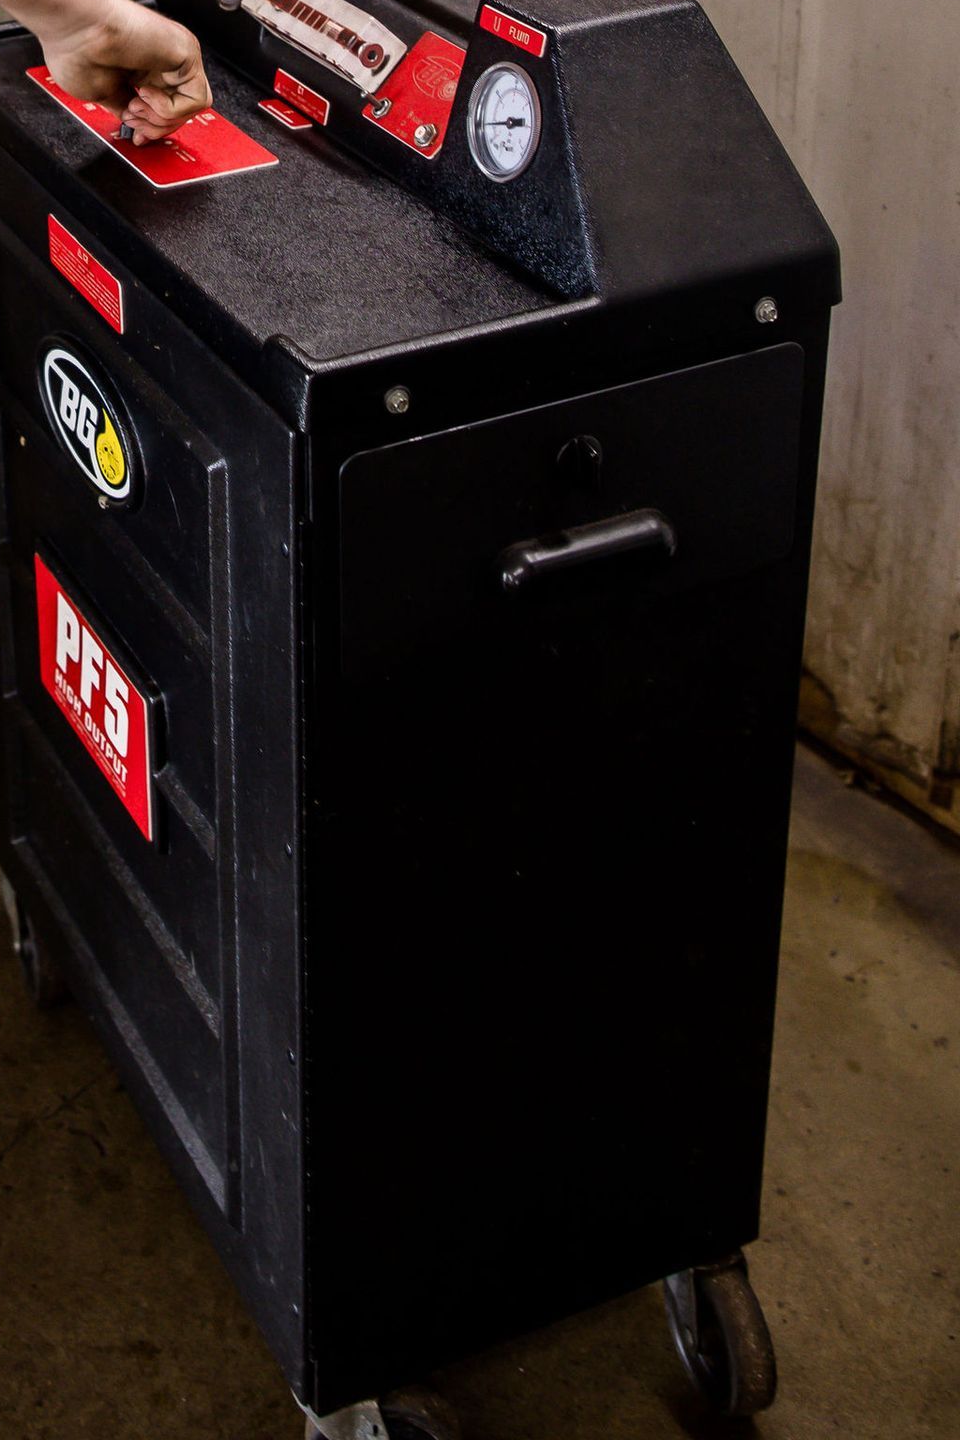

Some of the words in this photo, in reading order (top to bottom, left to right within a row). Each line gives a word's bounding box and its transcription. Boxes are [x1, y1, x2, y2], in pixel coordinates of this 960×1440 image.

[508, 26, 530, 45] FLUID
[60, 375, 98, 449] BG
[56, 591, 129, 758] PF5
[54, 668, 82, 716] HIGH
[84, 711, 128, 783] OUTPUT
